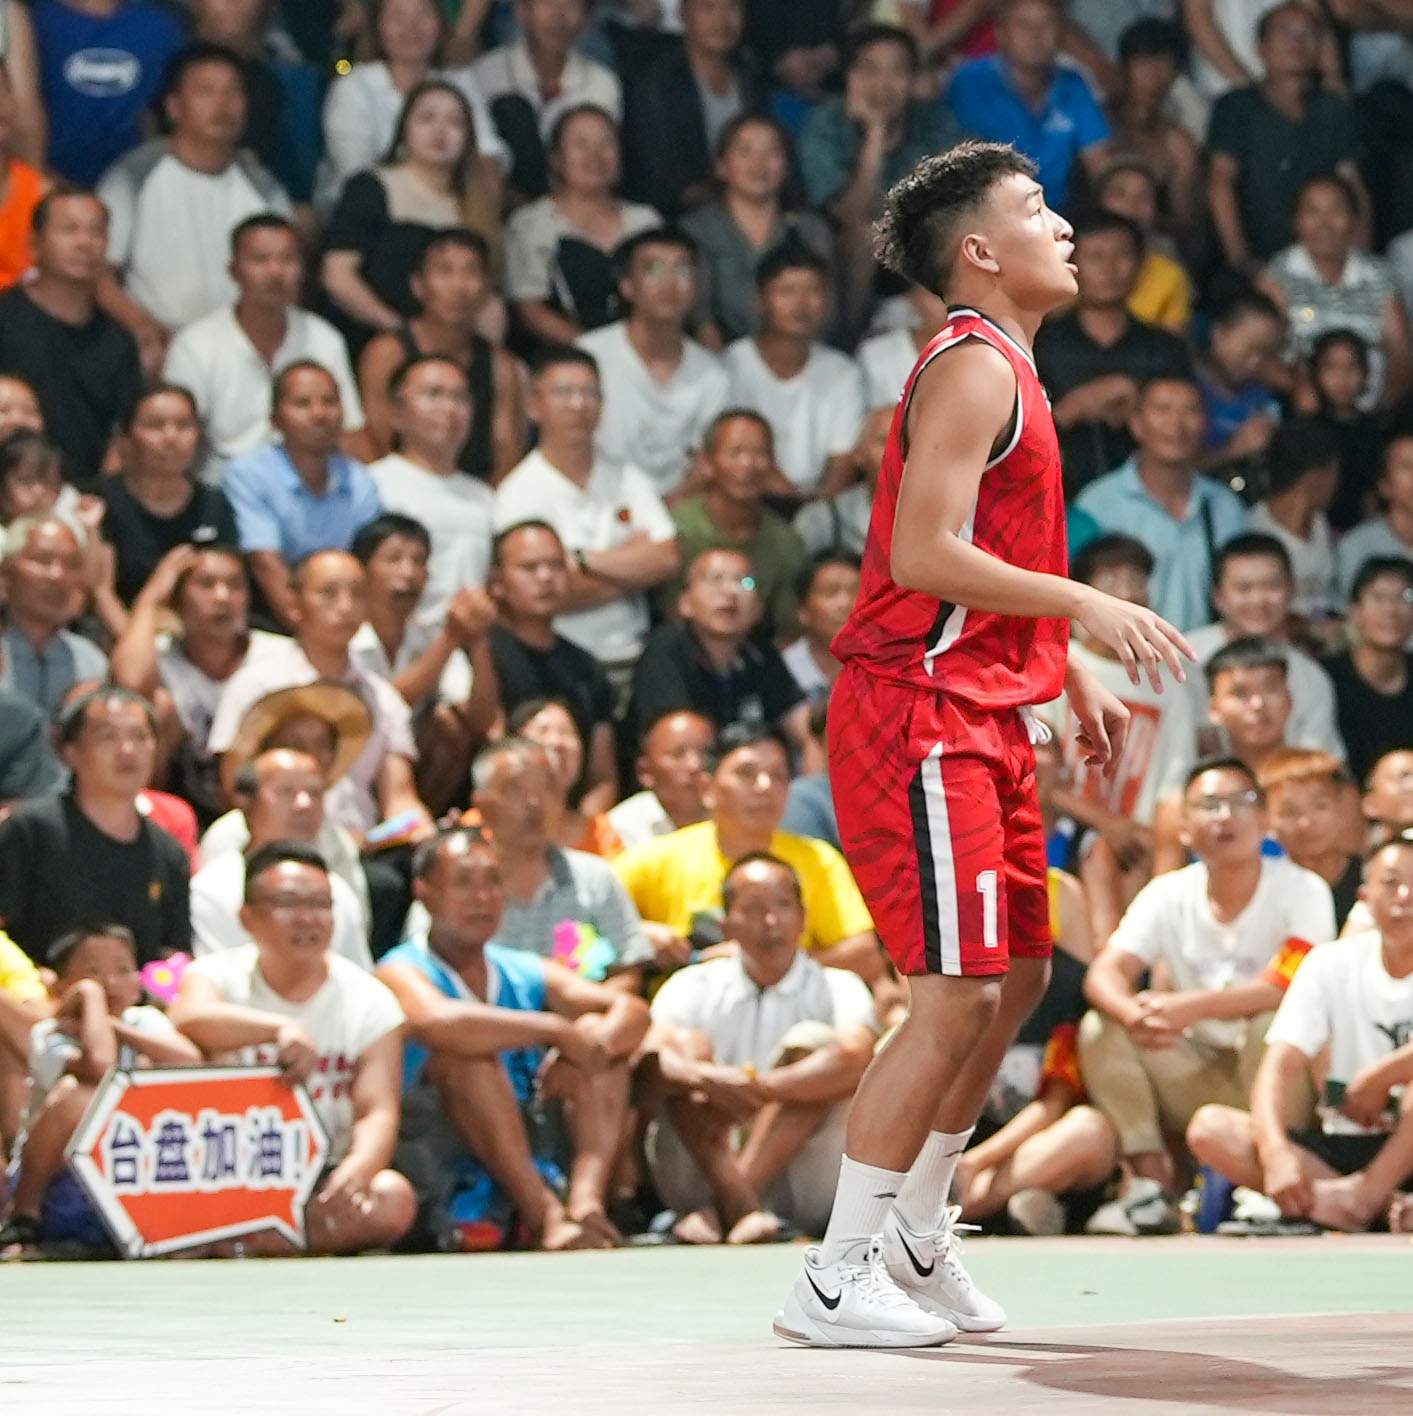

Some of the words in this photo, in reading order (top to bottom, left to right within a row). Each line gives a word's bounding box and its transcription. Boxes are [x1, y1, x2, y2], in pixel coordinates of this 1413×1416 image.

[976, 870, 998, 948] 1
[110, 1113, 304, 1186] 台盘加油!
